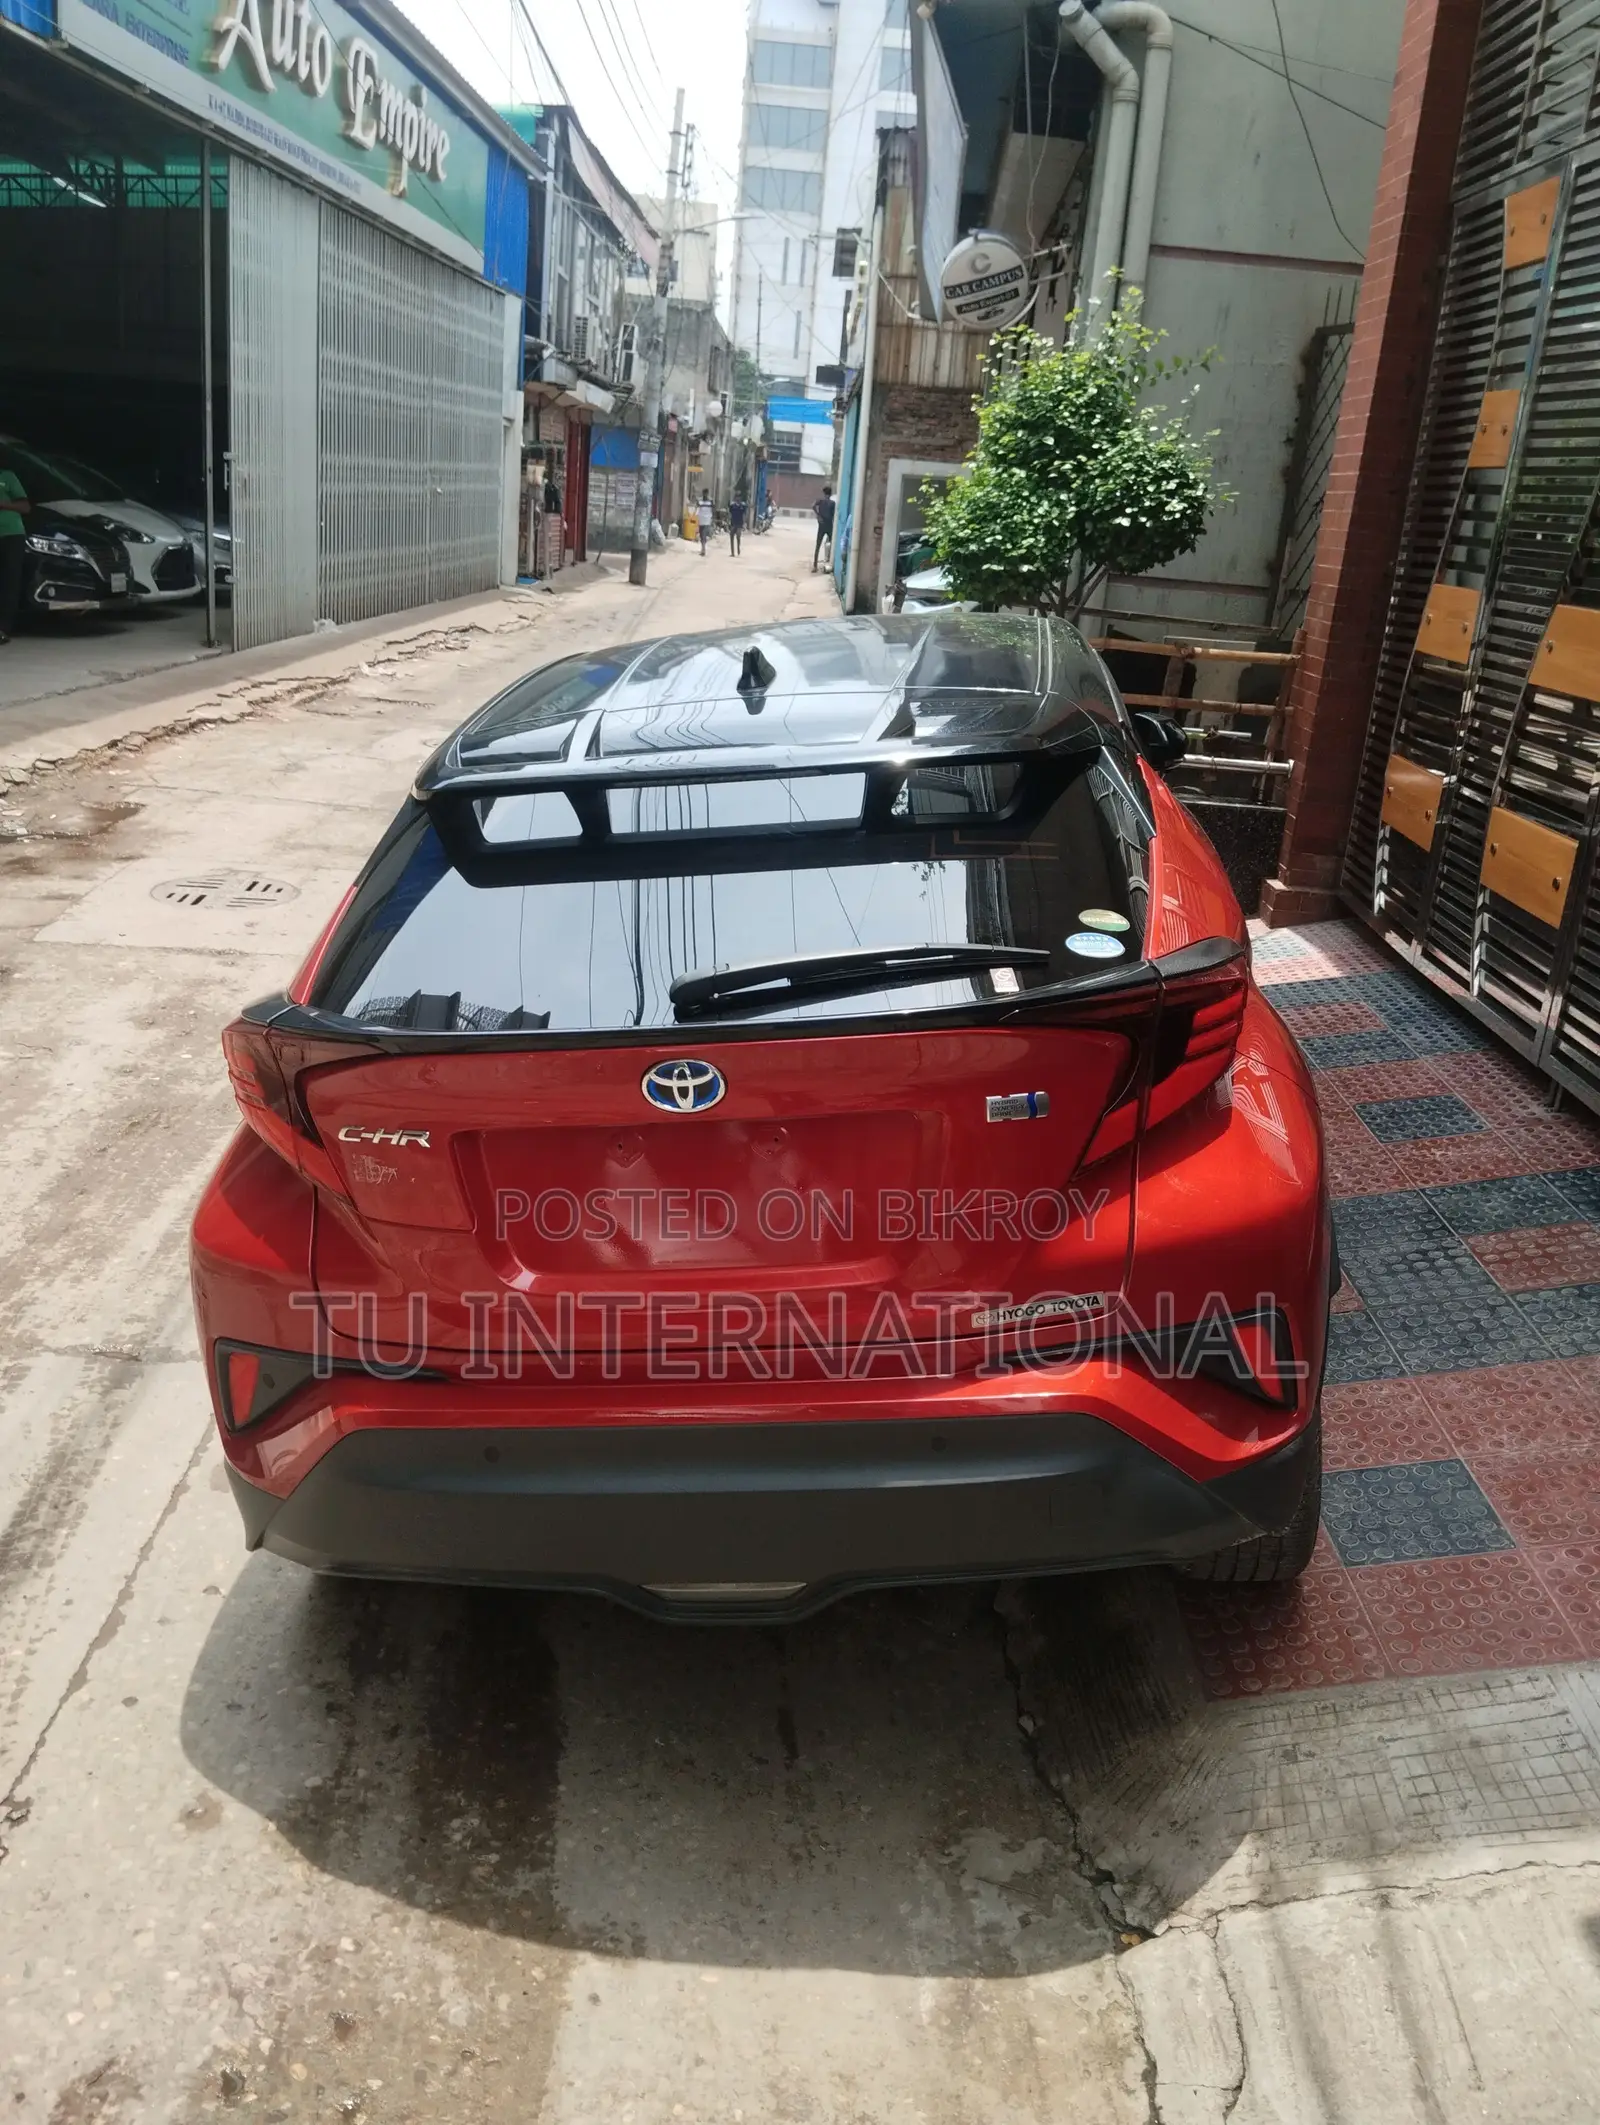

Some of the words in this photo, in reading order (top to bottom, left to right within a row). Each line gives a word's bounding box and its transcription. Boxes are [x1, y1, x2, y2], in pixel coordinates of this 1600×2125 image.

[219, 0, 331, 98] Auto
[346, 36, 450, 197] Empire
[945, 284, 971, 299] CAR
[972, 268, 1022, 292] CAMPUS
[991, 1104, 1026, 1112] SYNERGY
[338, 1125, 431, 1148] C-HR
[996, 1303, 1046, 1322] HYOGO
[1050, 1294, 1101, 1313] TOYOTA
